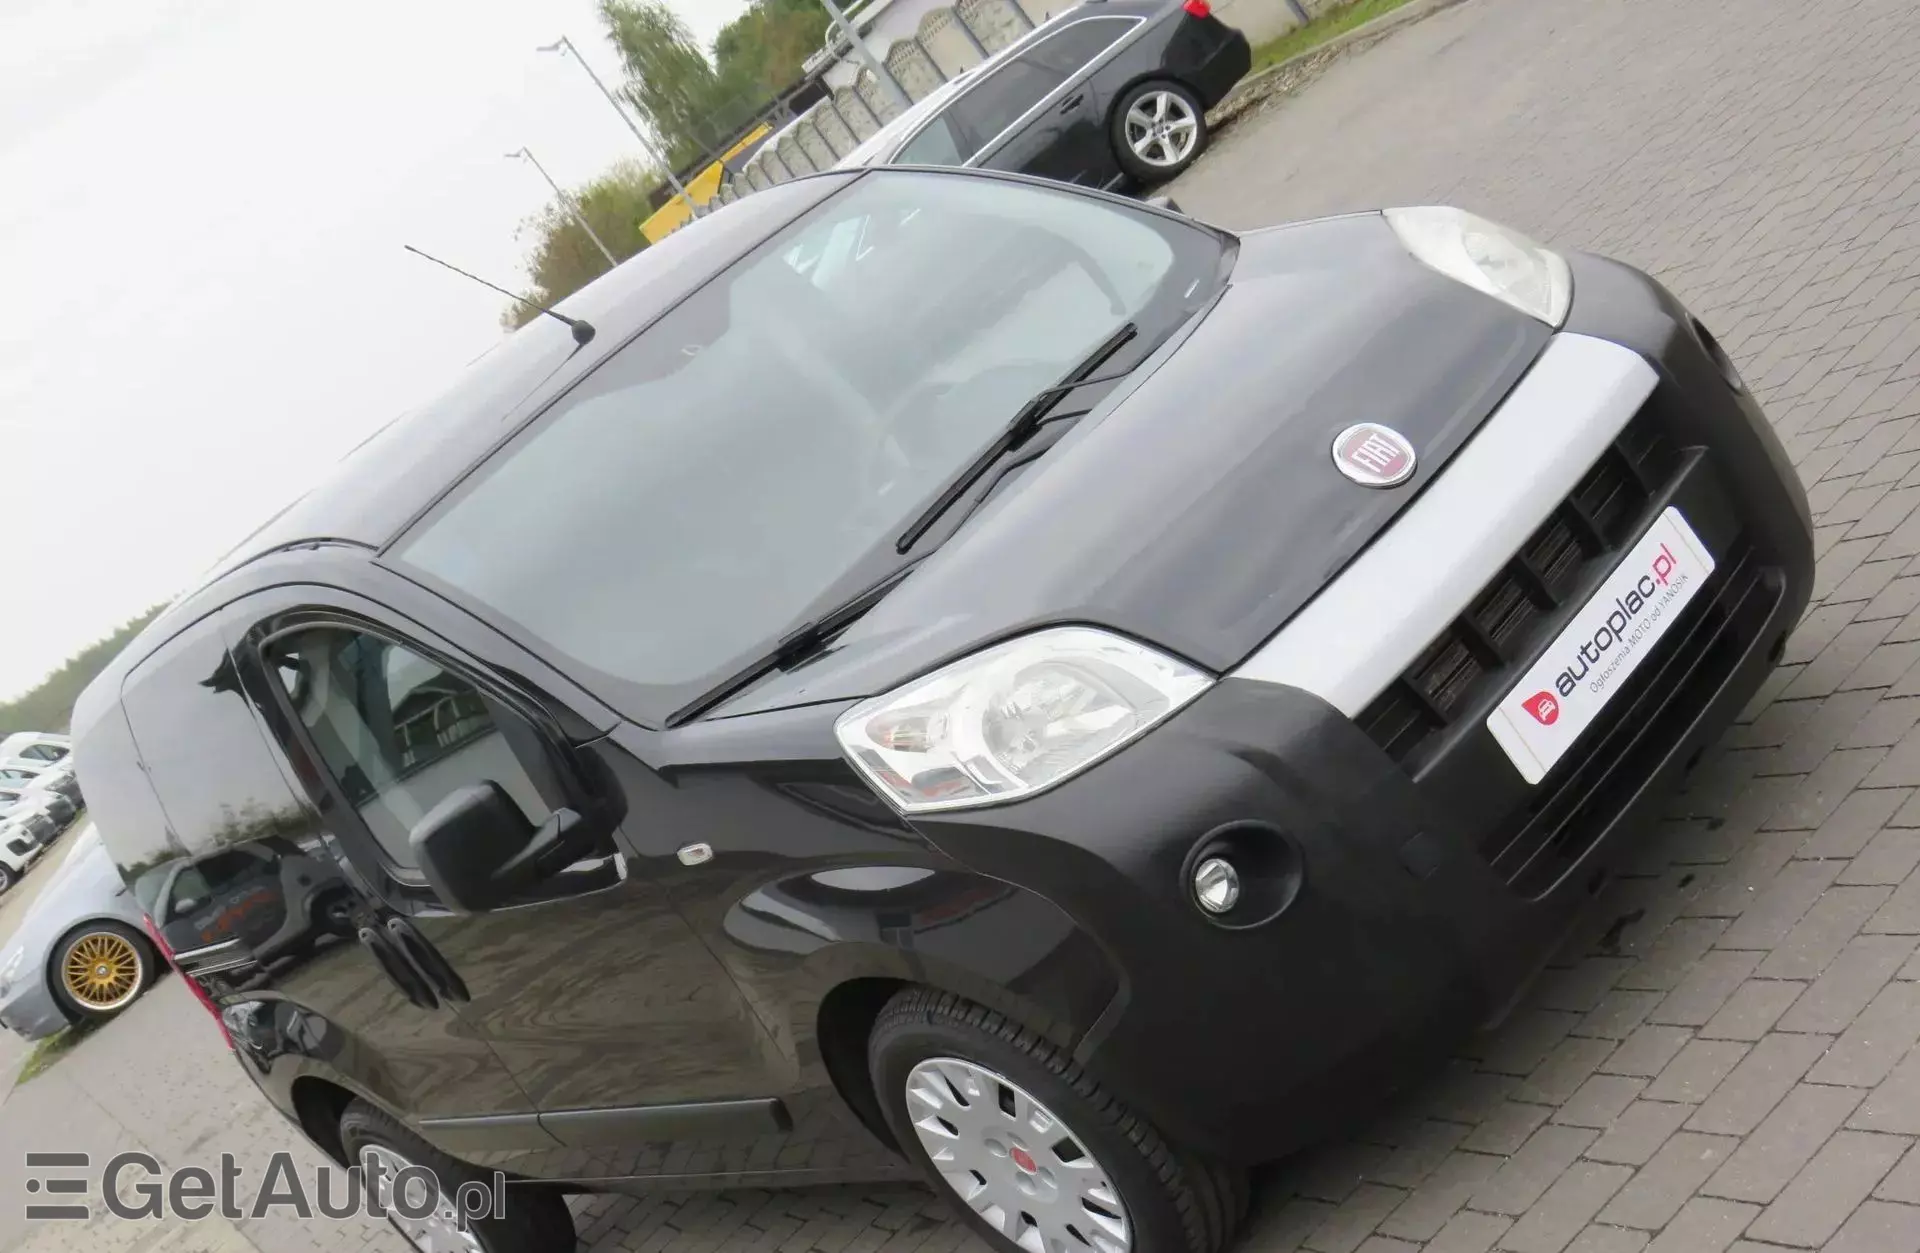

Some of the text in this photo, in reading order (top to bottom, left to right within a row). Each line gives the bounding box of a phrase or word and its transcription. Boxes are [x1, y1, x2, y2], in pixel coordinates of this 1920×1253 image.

[1351, 432, 1401, 474] FIAT
[1554, 542, 1677, 698] autoplac.pl
[1627, 617, 1652, 650] MOTO
[1650, 604, 1662, 622] od
[1660, 573, 1689, 609] YANOSIK
